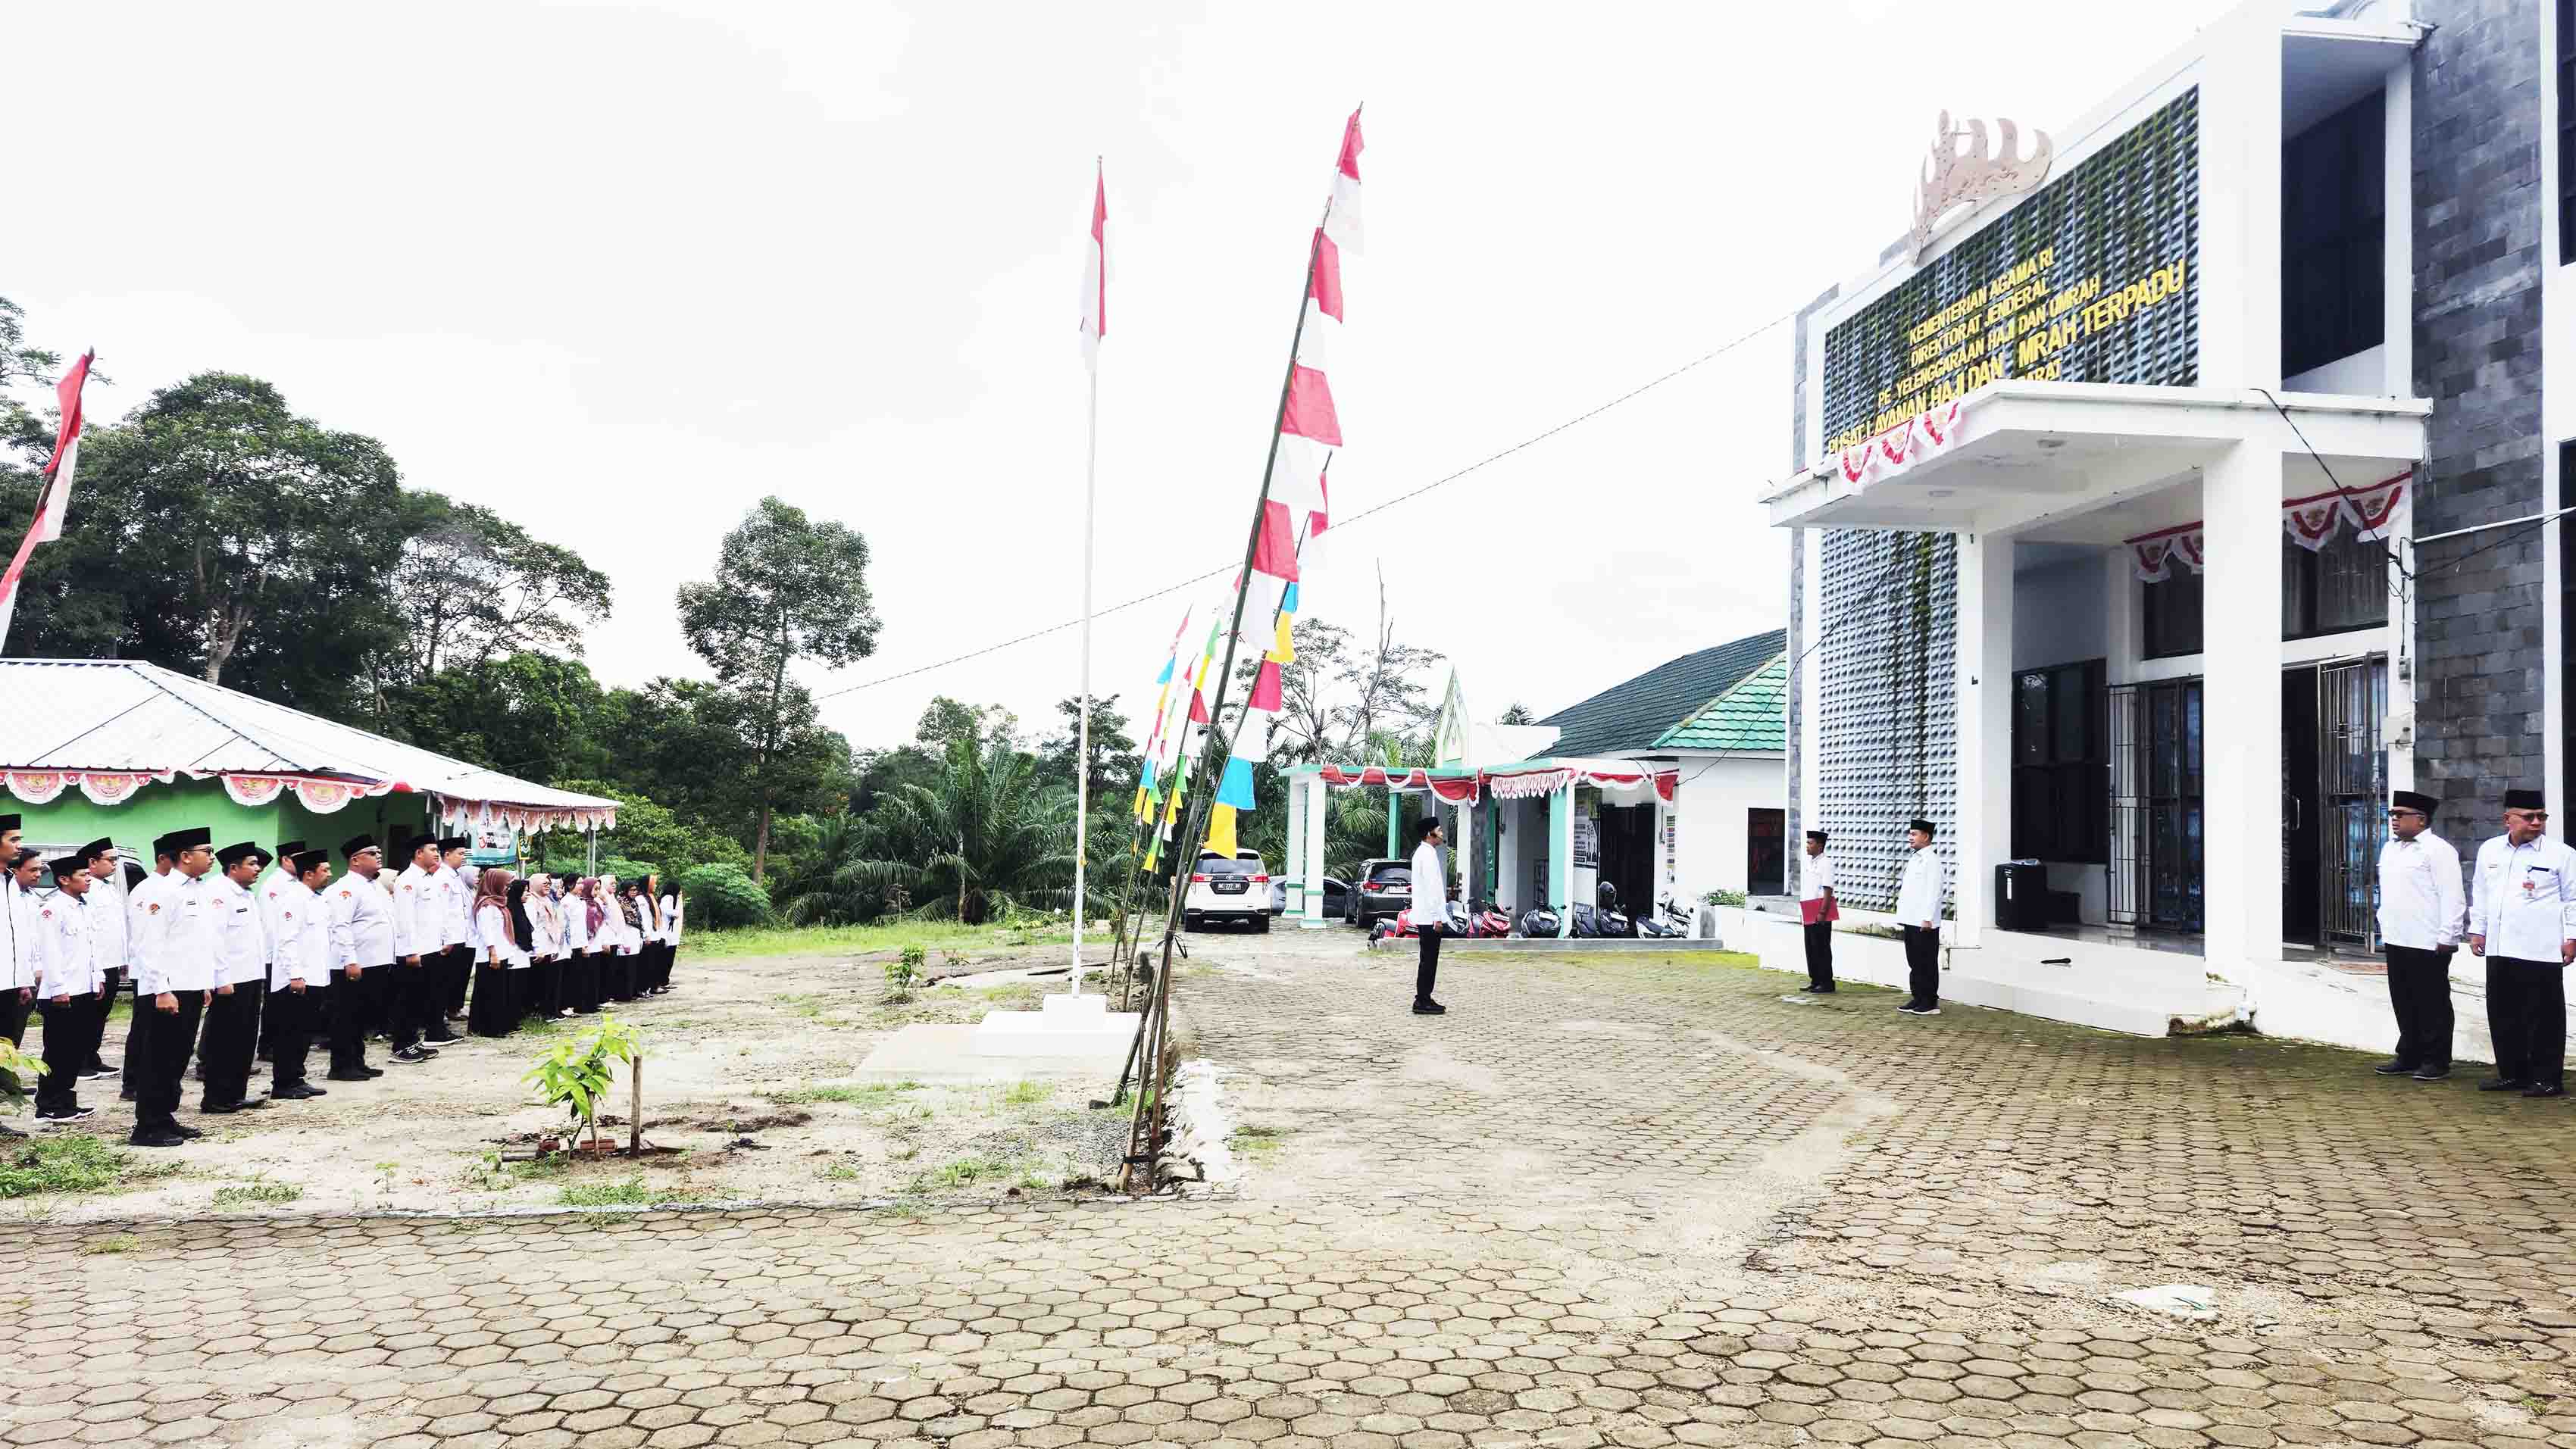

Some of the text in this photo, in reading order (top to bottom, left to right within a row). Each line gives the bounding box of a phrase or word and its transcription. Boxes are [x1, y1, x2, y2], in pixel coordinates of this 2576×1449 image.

[1909, 247, 2055, 346] KEMENTERIAN AGAMA RI
[1912, 278, 2050, 368] DIREKTORAT JENDERAL
[1968, 351, 2004, 390] DAN
[2018, 313, 2077, 368] MRAH
[2081, 258, 2185, 336] TERPADU
[1988, 315, 2015, 351] HAJI
[2018, 304, 2046, 335] DAN
[2048, 273, 2101, 318] UMRAH
[2017, 358, 2062, 382] ARAT
